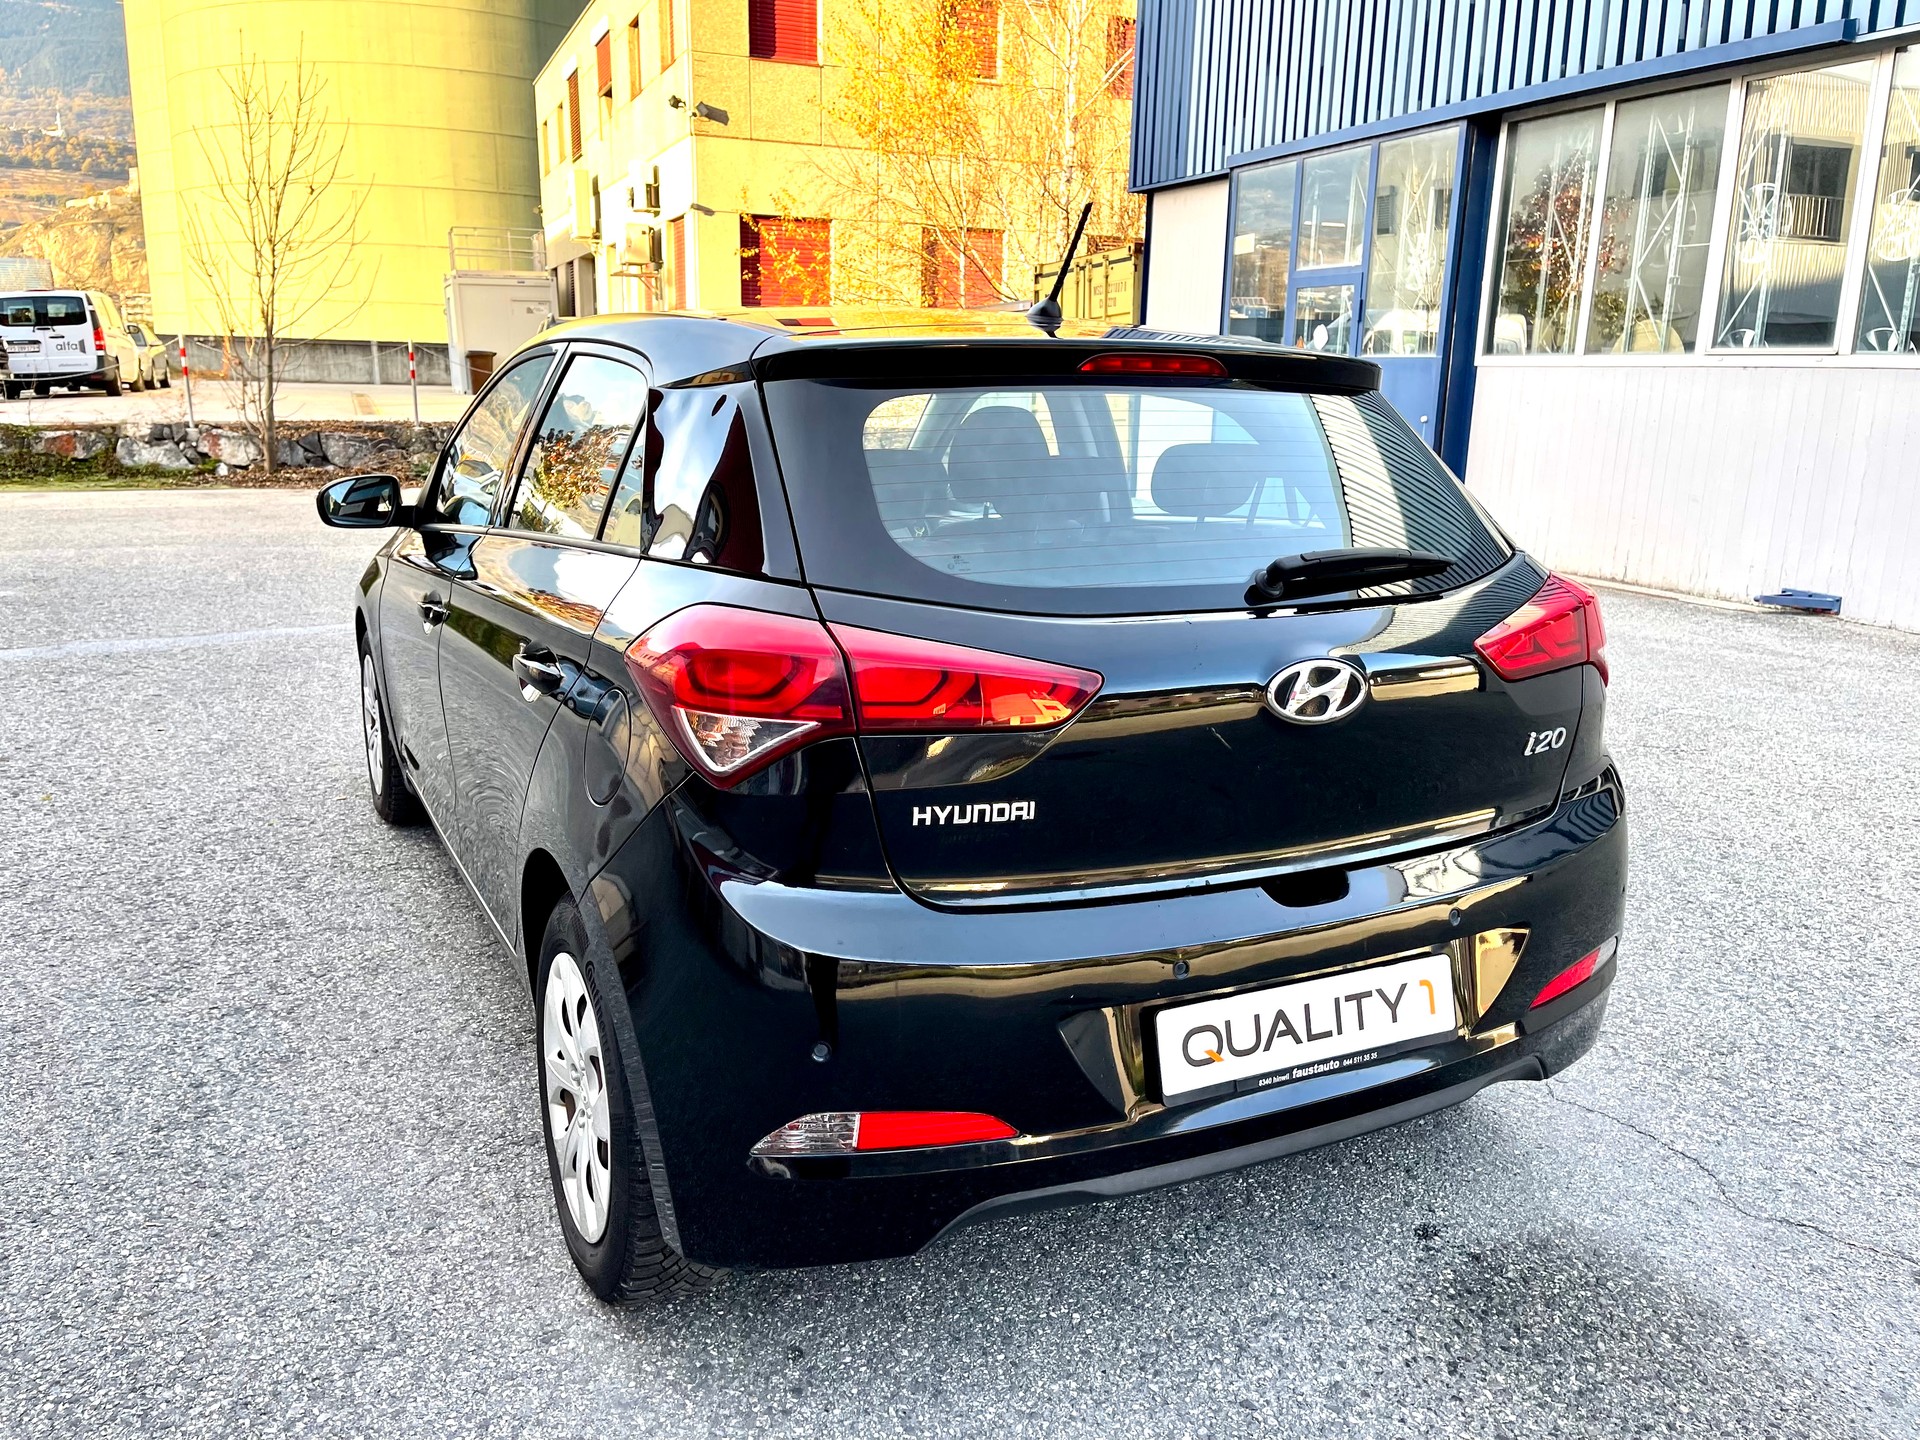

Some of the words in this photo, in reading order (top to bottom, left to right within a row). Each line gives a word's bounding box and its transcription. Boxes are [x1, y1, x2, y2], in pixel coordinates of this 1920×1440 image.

[56, 341, 78, 351] alfa
[1524, 727, 1567, 756] i20
[912, 801, 1036, 826] HYUNDAI
[1182, 982, 1408, 1068] QUALITY
[1419, 979, 1436, 1015] 1
[1292, 1060, 1340, 1079] faustauto
